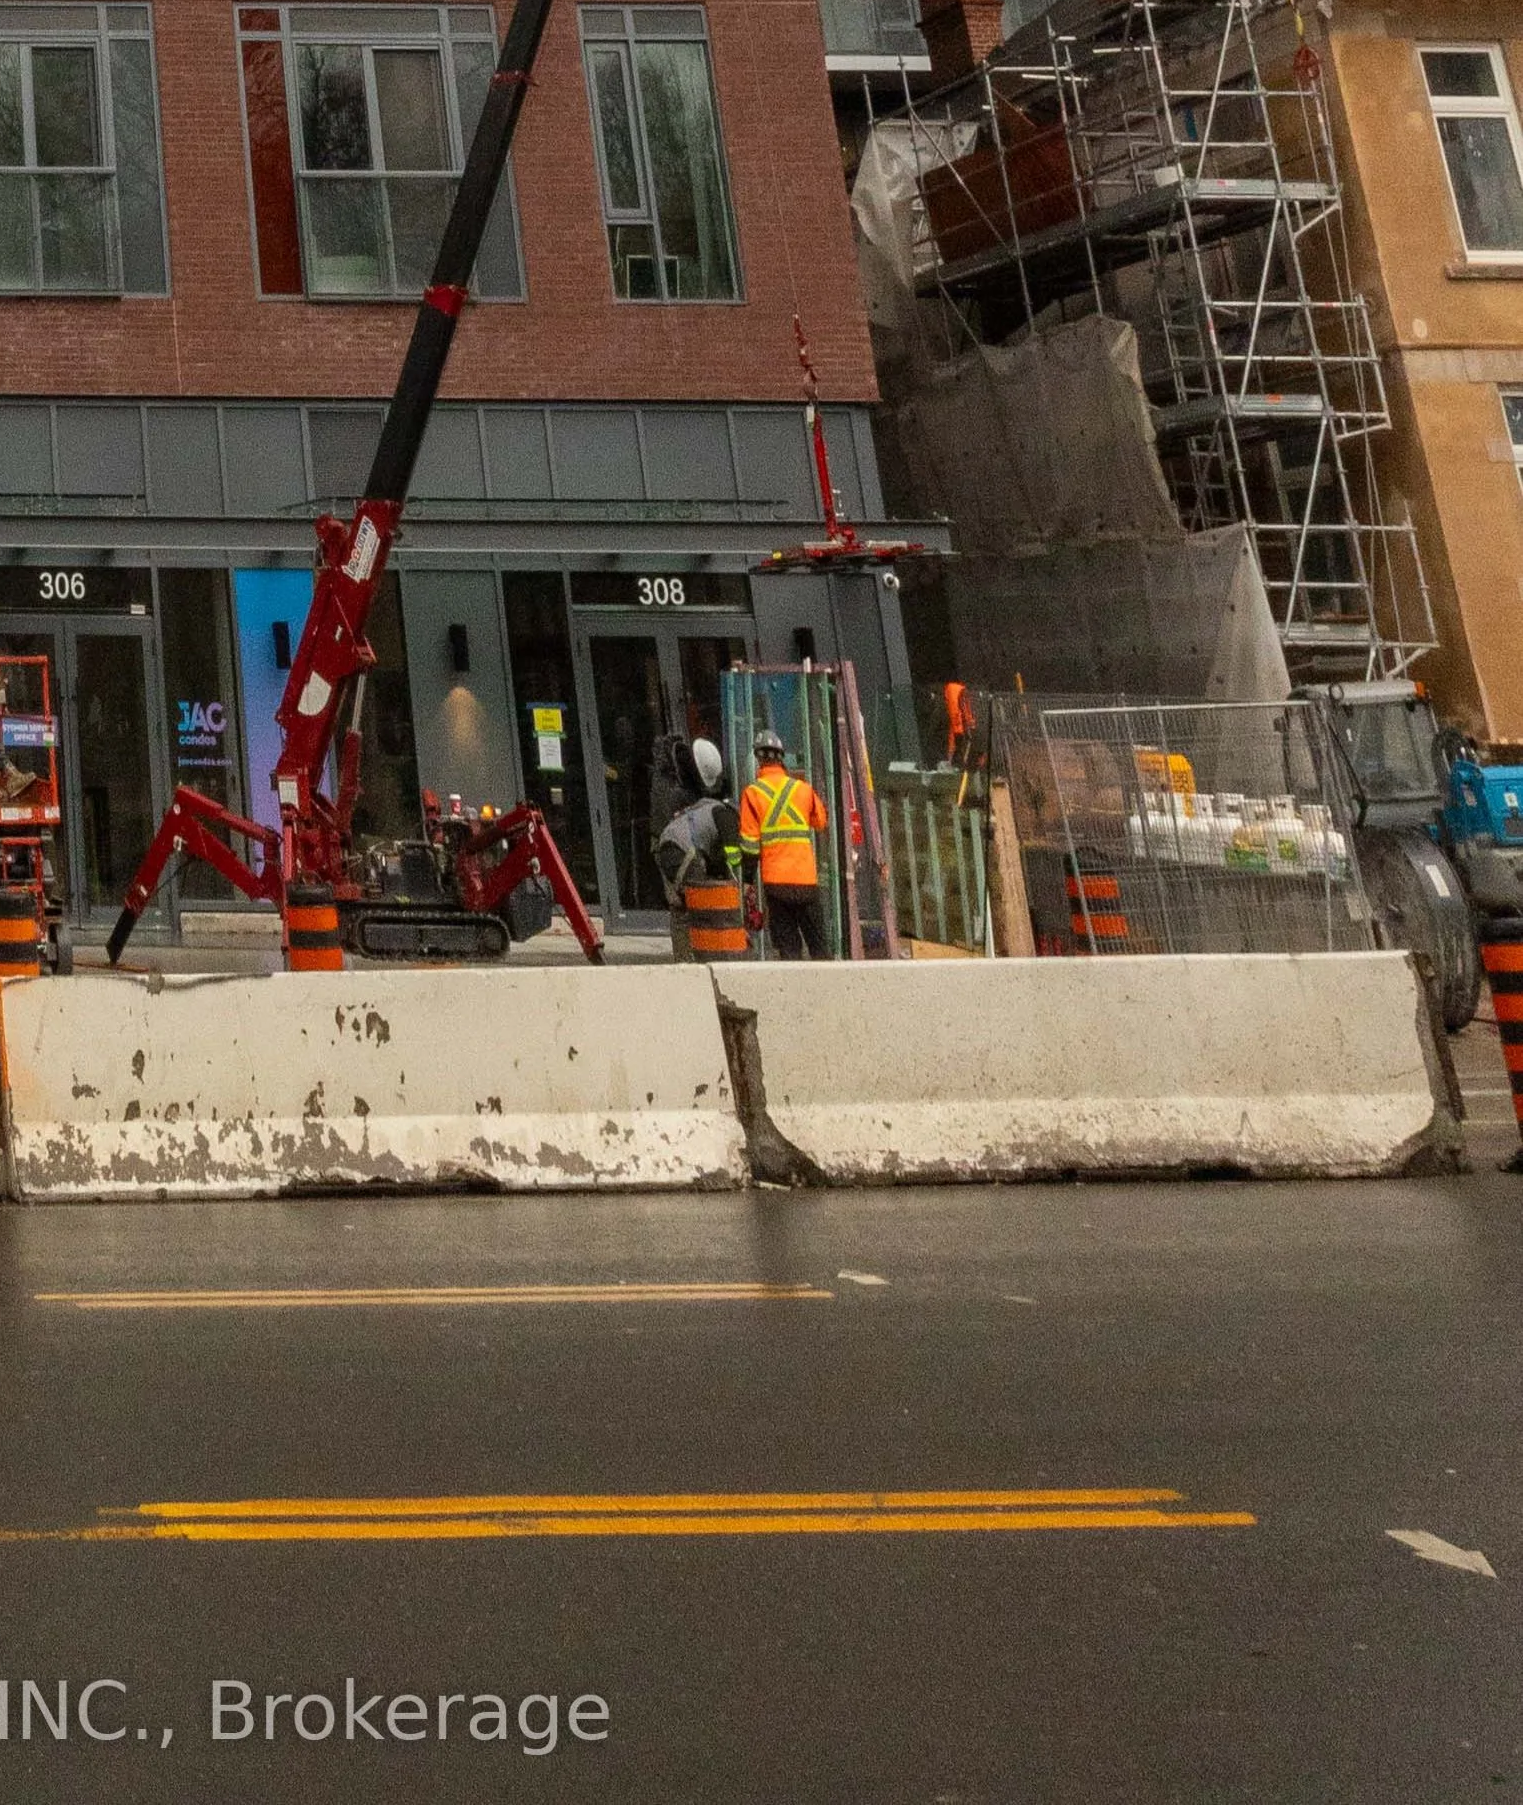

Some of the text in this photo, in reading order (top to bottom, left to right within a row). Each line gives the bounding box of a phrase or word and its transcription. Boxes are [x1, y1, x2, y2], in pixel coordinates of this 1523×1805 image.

[40, 572, 85, 599] 306
[638, 578, 685, 605] 308
[177, 701, 227, 732] JAC
